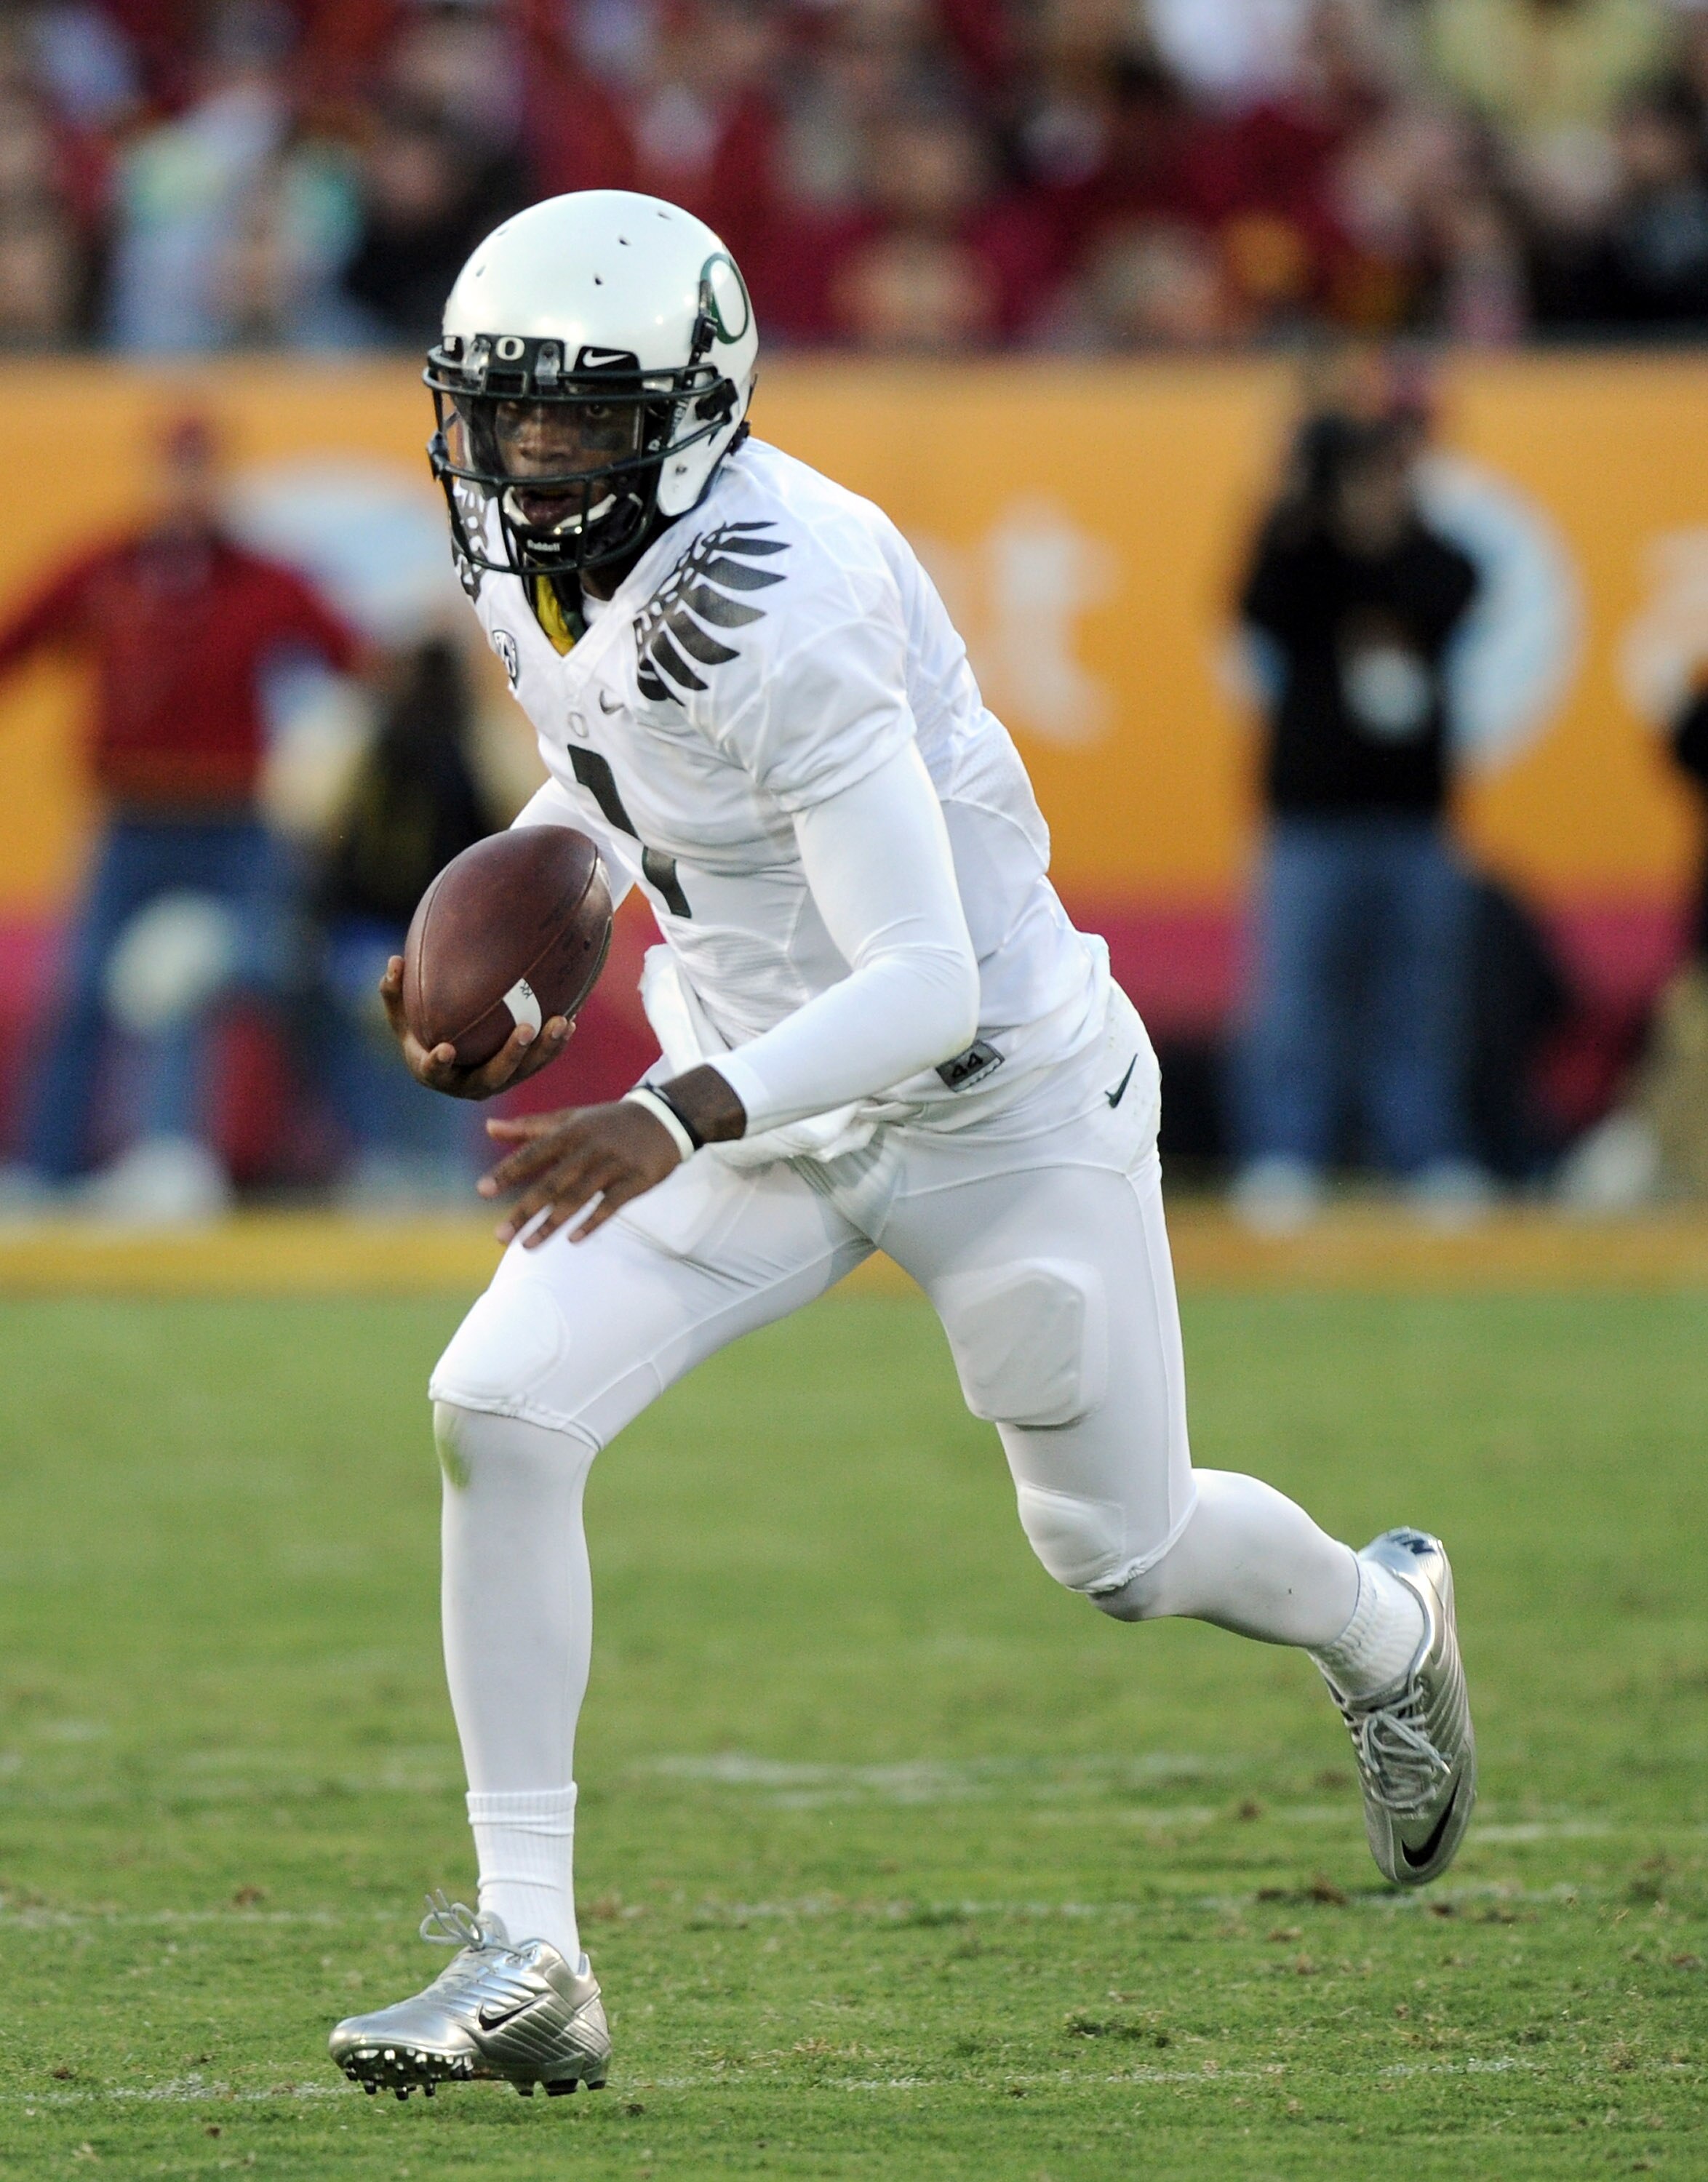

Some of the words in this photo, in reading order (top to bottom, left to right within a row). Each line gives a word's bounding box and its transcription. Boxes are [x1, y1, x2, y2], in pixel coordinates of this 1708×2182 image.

[495, 336, 525, 361] O
[567, 744, 692, 919] 1
[952, 1052, 983, 1078] 44
